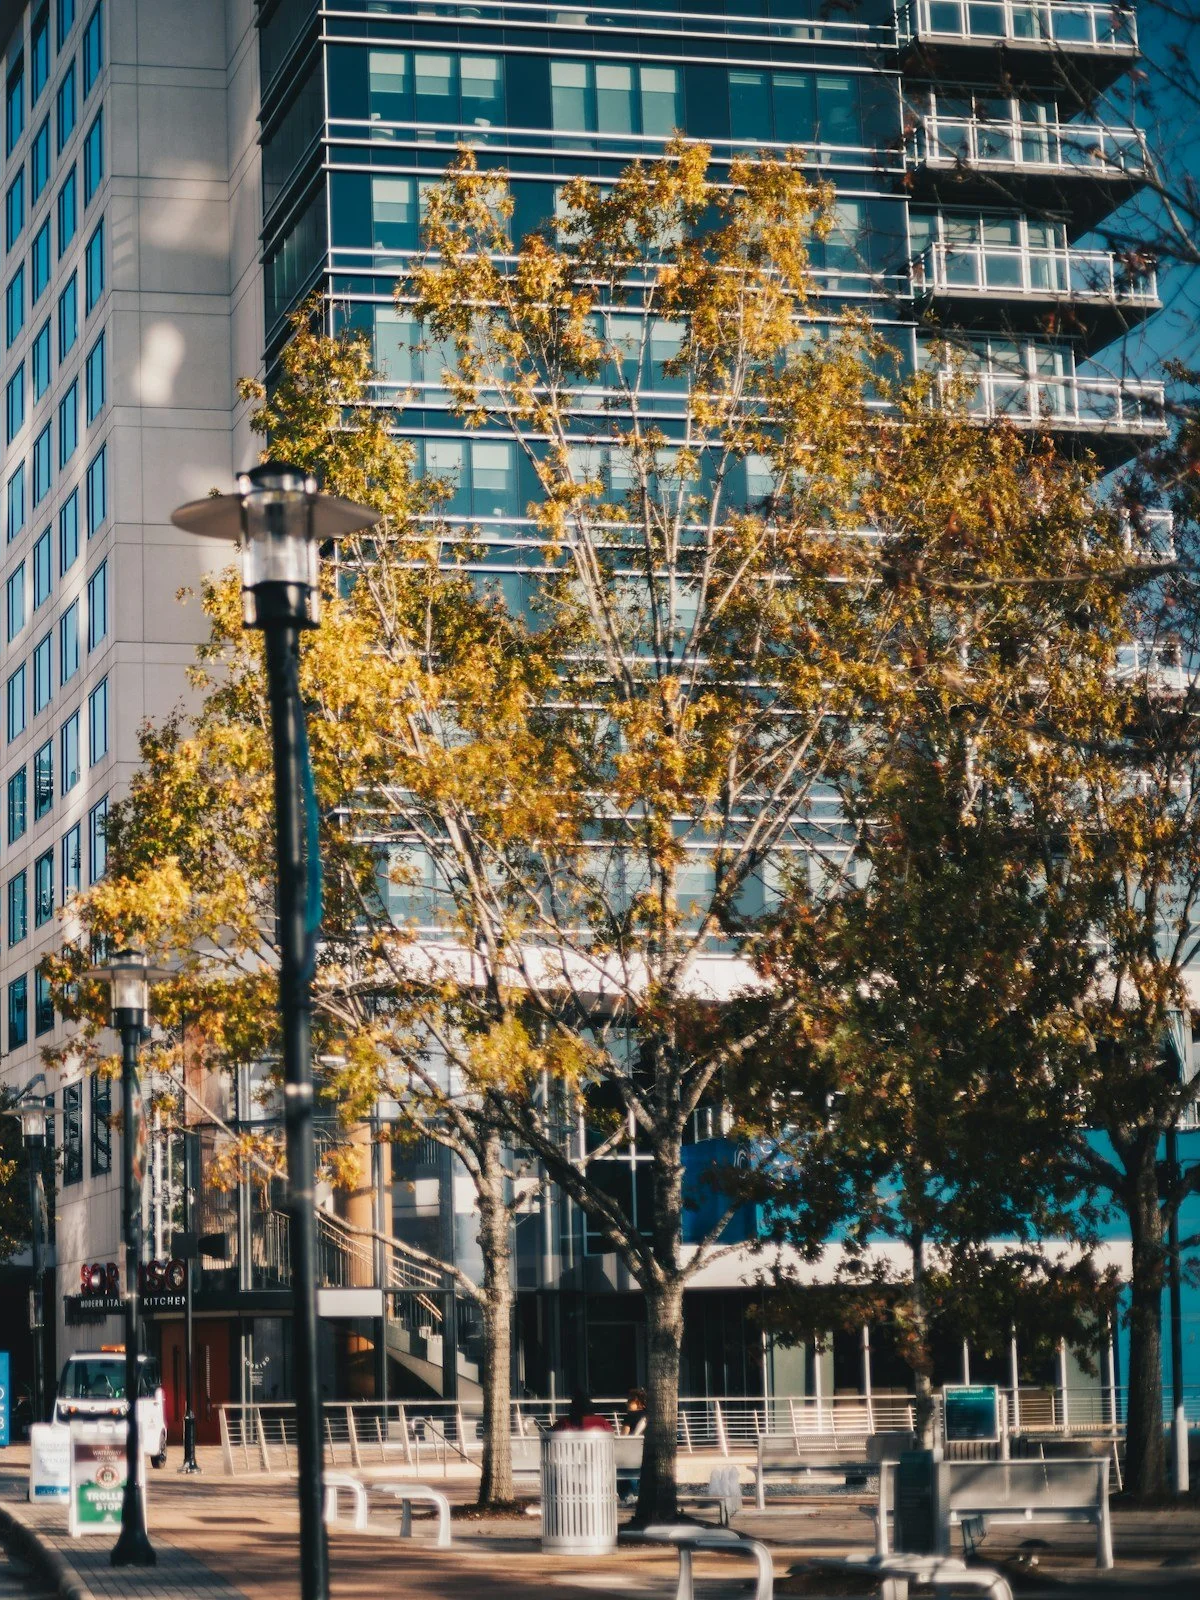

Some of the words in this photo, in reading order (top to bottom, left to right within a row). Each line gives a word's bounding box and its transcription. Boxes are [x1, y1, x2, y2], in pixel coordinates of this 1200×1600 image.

[81, 1260, 185, 1297] SORISO
[81, 1300, 104, 1308] MODERN
[87, 1491, 124, 1501] TROLLE
[95, 1502, 122, 1511] STOP
